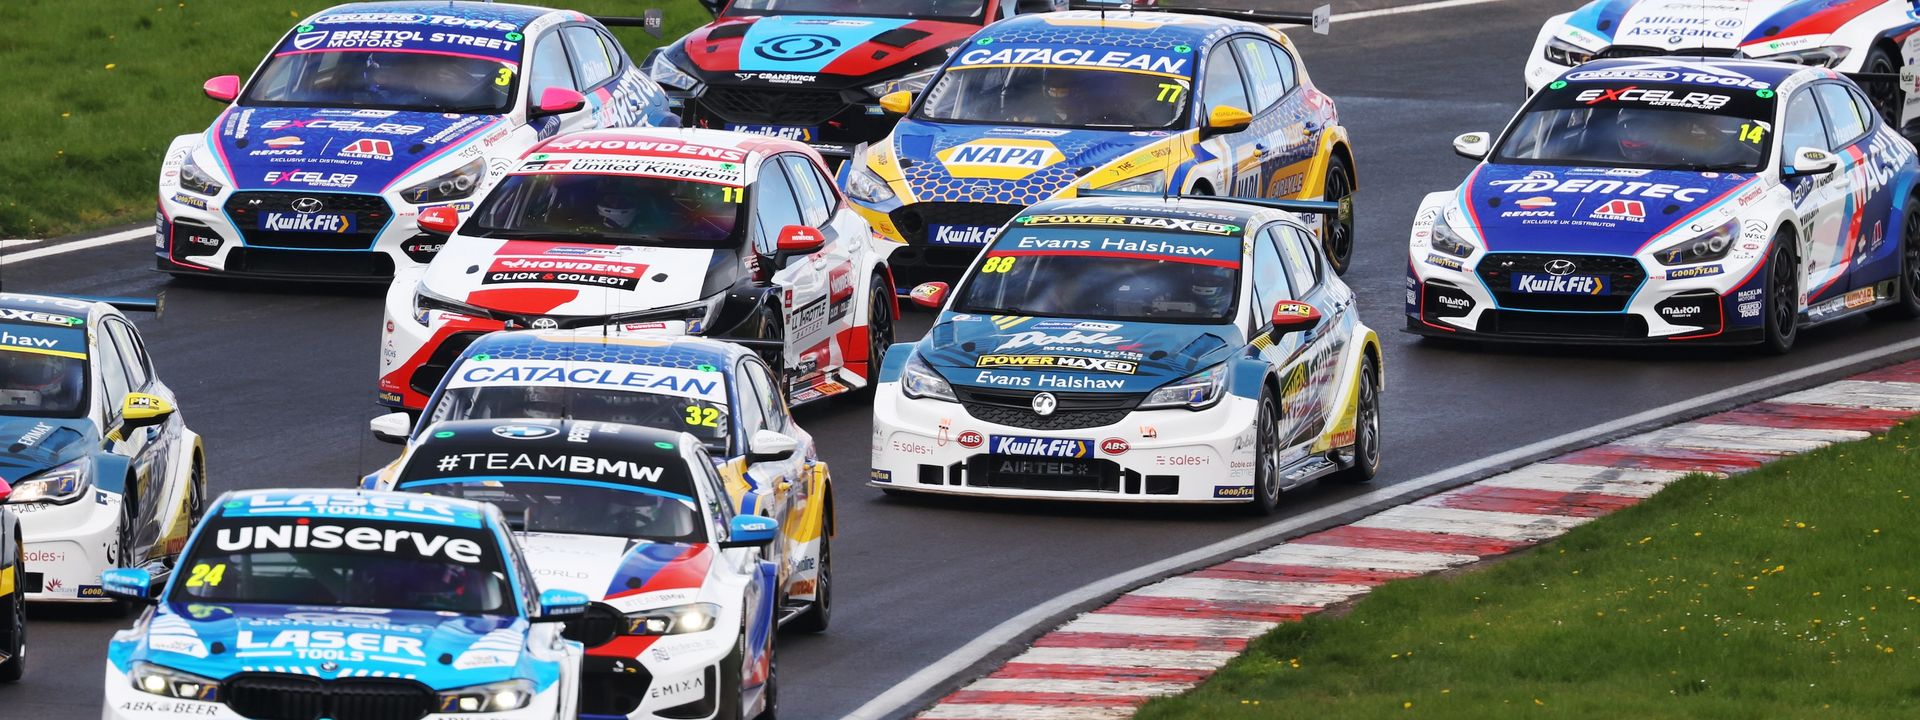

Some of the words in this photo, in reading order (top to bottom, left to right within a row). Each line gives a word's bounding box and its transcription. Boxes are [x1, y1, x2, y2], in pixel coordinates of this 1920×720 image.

[427, 15, 518, 31] Tools
[1635, 15, 1710, 26] Allianz
[330, 30, 425, 42] BRISTOL
[430, 33, 518, 51] STREET
[1626, 24, 1735, 40] Assistance
[327, 39, 404, 49] MOTORS
[960, 49, 1187, 75] CATACLEAN
[495, 67, 513, 86] 3
[758, 73, 817, 83] CRANSWICK
[1575, 70, 1667, 81] DRAPER
[1681, 72, 1771, 90] Tools
[612, 65, 668, 130] BRISTOL
[1156, 83, 1184, 103] 77
[1575, 86, 1732, 107] EXCELR8
[1649, 101, 1721, 111] MOTORSPORT
[260, 117, 425, 134] EXCELR8
[1738, 123, 1765, 144] 14
[580, 139, 746, 161] HOWDENS
[953, 145, 1047, 167] NAPA
[1806, 151, 1825, 159] HRS
[319, 158, 364, 166] DISTRIBUTOR
[1117, 160, 1135, 174] THE
[1850, 120, 1914, 213] MACKLIN
[263, 168, 359, 185] EXCELR8
[572, 162, 645, 173] United
[643, 164, 738, 182] Kingdom
[1271, 171, 1304, 199] CARLYLE
[721, 187, 744, 204] 11
[265, 212, 340, 232] KwikFit
[1501, 209, 1556, 218] REPSOL
[1589, 213, 1625, 222] MILLERS
[1030, 215, 1127, 226] POWER
[1129, 217, 1231, 233] MAXED
[1571, 220, 1616, 228] DISTRIBUTOR
[1744, 232, 1766, 240] WSC
[1017, 235, 1092, 249] Evans
[1100, 238, 1215, 257] Halshaw
[525, 260, 637, 275] HOWDENS
[981, 256, 1016, 274] 88
[1428, 255, 1461, 268] GOODYEAR
[491, 272, 540, 281] CLICK
[542, 272, 555, 281] &
[556, 272, 629, 287] COLLECT
[1671, 265, 1719, 278] GOODYEAR
[1517, 274, 1595, 294] KwikFit
[1738, 288, 1763, 298] MACKLIN
[0, 308, 71, 325] AXED
[1279, 304, 1310, 313] PMR
[1741, 310, 1760, 319] TOOLS
[1, 331, 60, 348] haw
[990, 330, 1133, 352] Doble
[384, 348, 397, 358] FUCHS
[1042, 345, 1144, 359] MOTORCYCLES
[979, 356, 1055, 366] POWER
[1056, 356, 1133, 372] MAXED
[463, 366, 718, 396] CATACLEAN
[975, 370, 1032, 387] Evans
[1037, 374, 1126, 390] Halshaw
[128, 396, 160, 407] PMR
[684, 405, 719, 428] 32
[18, 421, 52, 447] EPIMAX
[959, 434, 981, 443] ABS
[901, 441, 934, 455] sales-i
[997, 436, 1077, 457] KwikFit
[1104, 442, 1127, 450] ABS
[436, 452, 665, 483] #TEAMBMW
[1000, 460, 1074, 475] AIRTEC
[1168, 454, 1210, 466] sales-i
[249, 493, 455, 516] LASER
[314, 504, 389, 517] TOOLS
[23, 549, 65, 563] sales-i
[185, 563, 227, 587] 24
[235, 629, 427, 658] LASER
[296, 649, 366, 662] TOOLS
[650, 677, 703, 699] EMIXA
[120, 701, 157, 712] ABK
[173, 703, 218, 716] BEER
